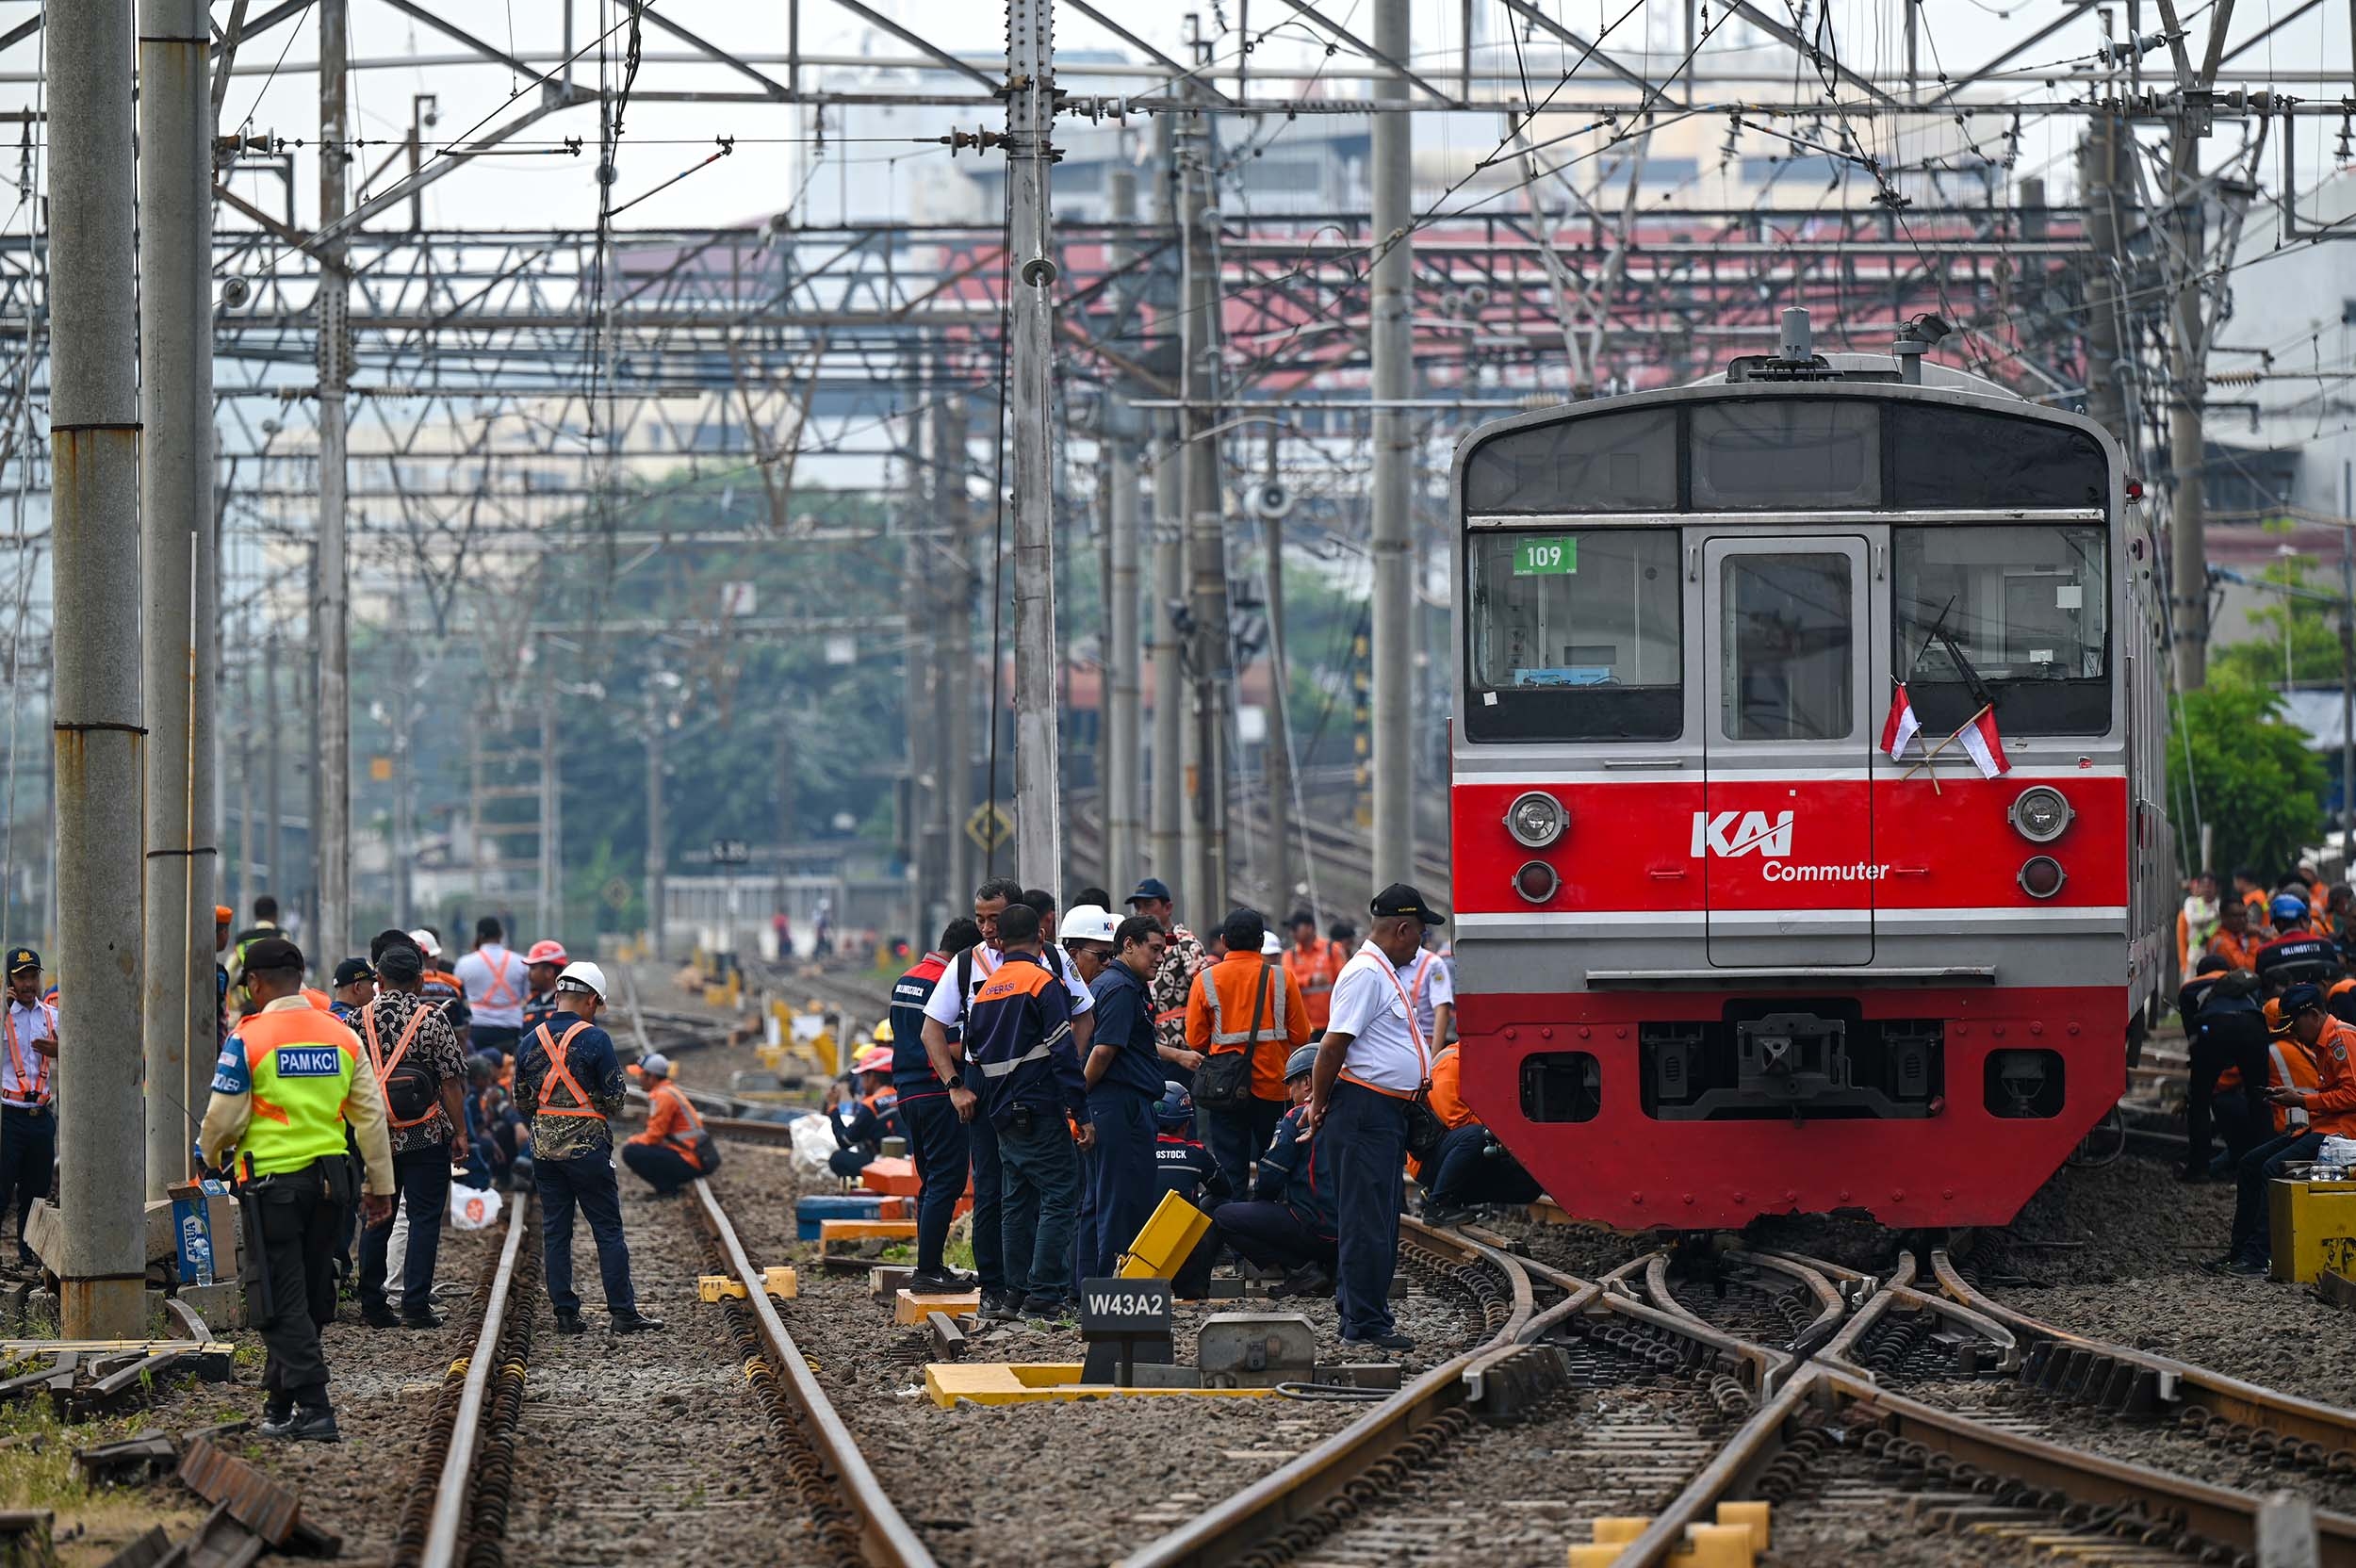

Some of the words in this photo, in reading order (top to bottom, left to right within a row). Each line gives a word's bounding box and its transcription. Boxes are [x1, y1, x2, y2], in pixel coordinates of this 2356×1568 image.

[1528, 547, 1562, 566] 109
[1691, 810, 1794, 858] KAI
[1762, 860, 1890, 882] Commuter
[986, 983, 1015, 995] OPERASI
[186, 1221, 197, 1259] AQUA
[1088, 1294, 1163, 1315] W43A2
